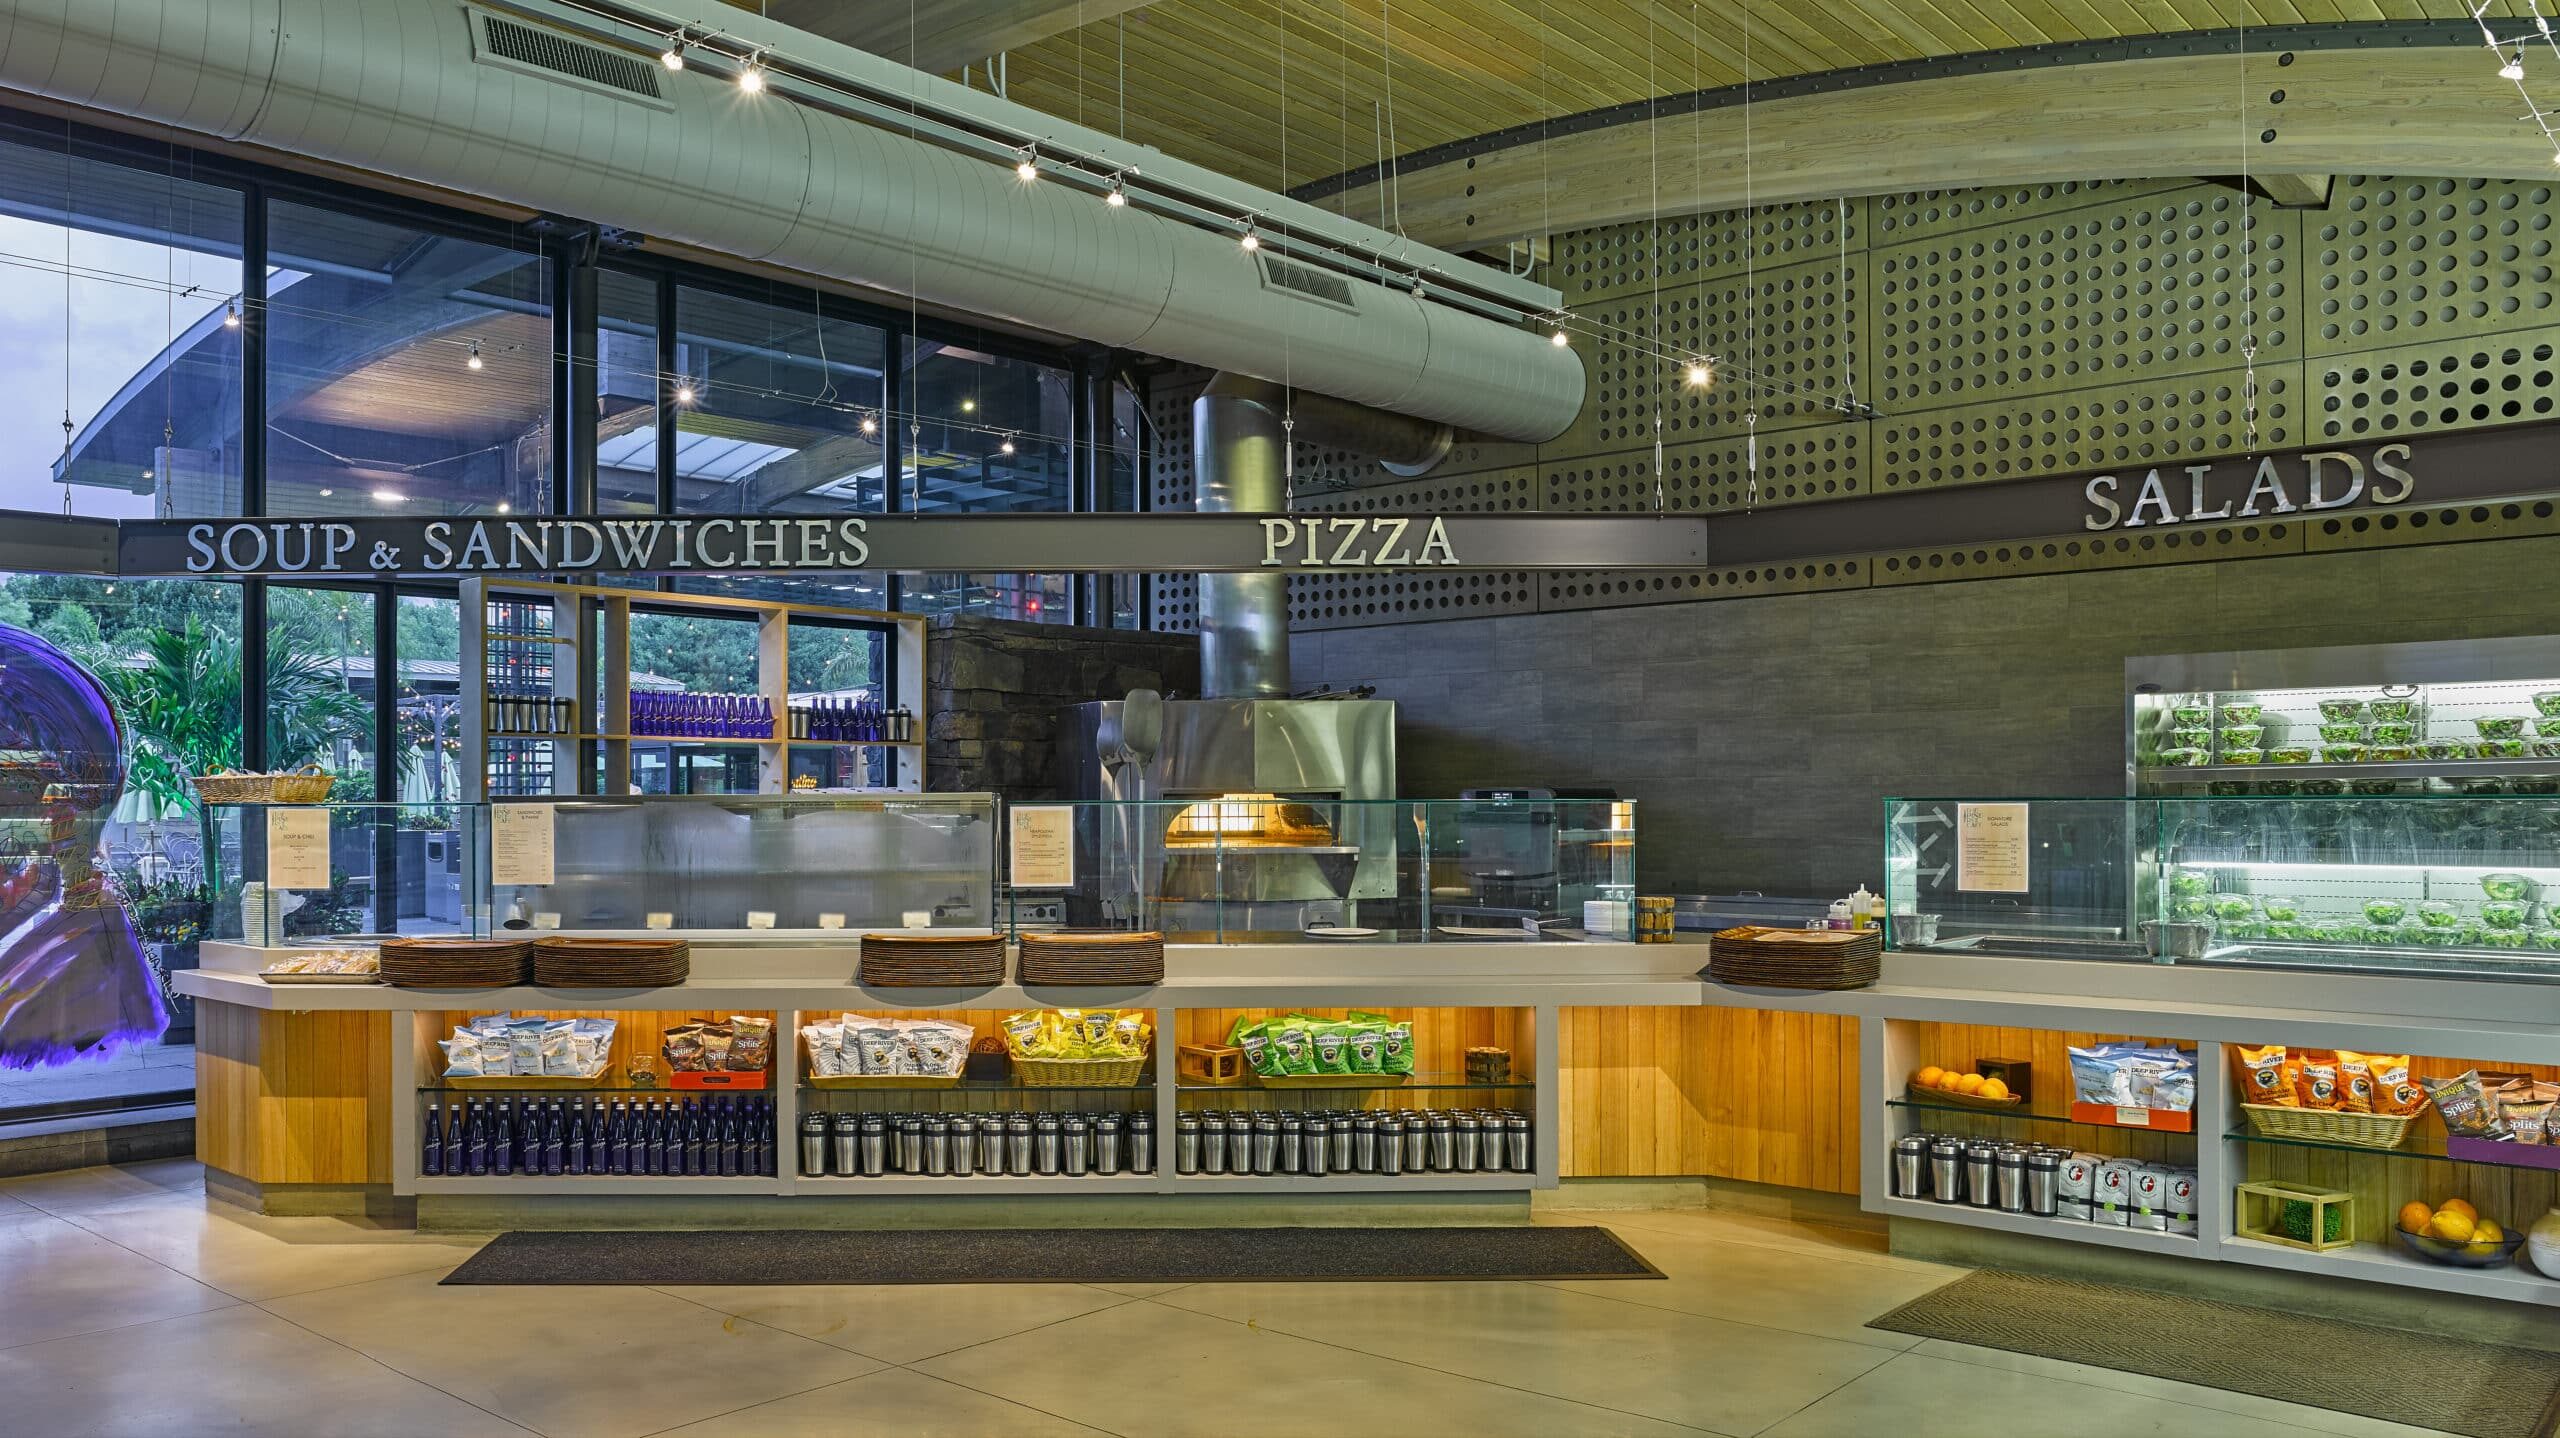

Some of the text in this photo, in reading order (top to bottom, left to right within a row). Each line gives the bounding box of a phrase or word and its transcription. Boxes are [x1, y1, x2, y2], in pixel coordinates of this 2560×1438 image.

[2085, 443, 2414, 531] SALADS
[186, 518, 869, 572] SOUP & SANDWICHES
[1259, 516, 1460, 565] PIZZA
[2434, 1082, 2467, 1099] UNIQUE
[2443, 1101, 2476, 1118] Splits
